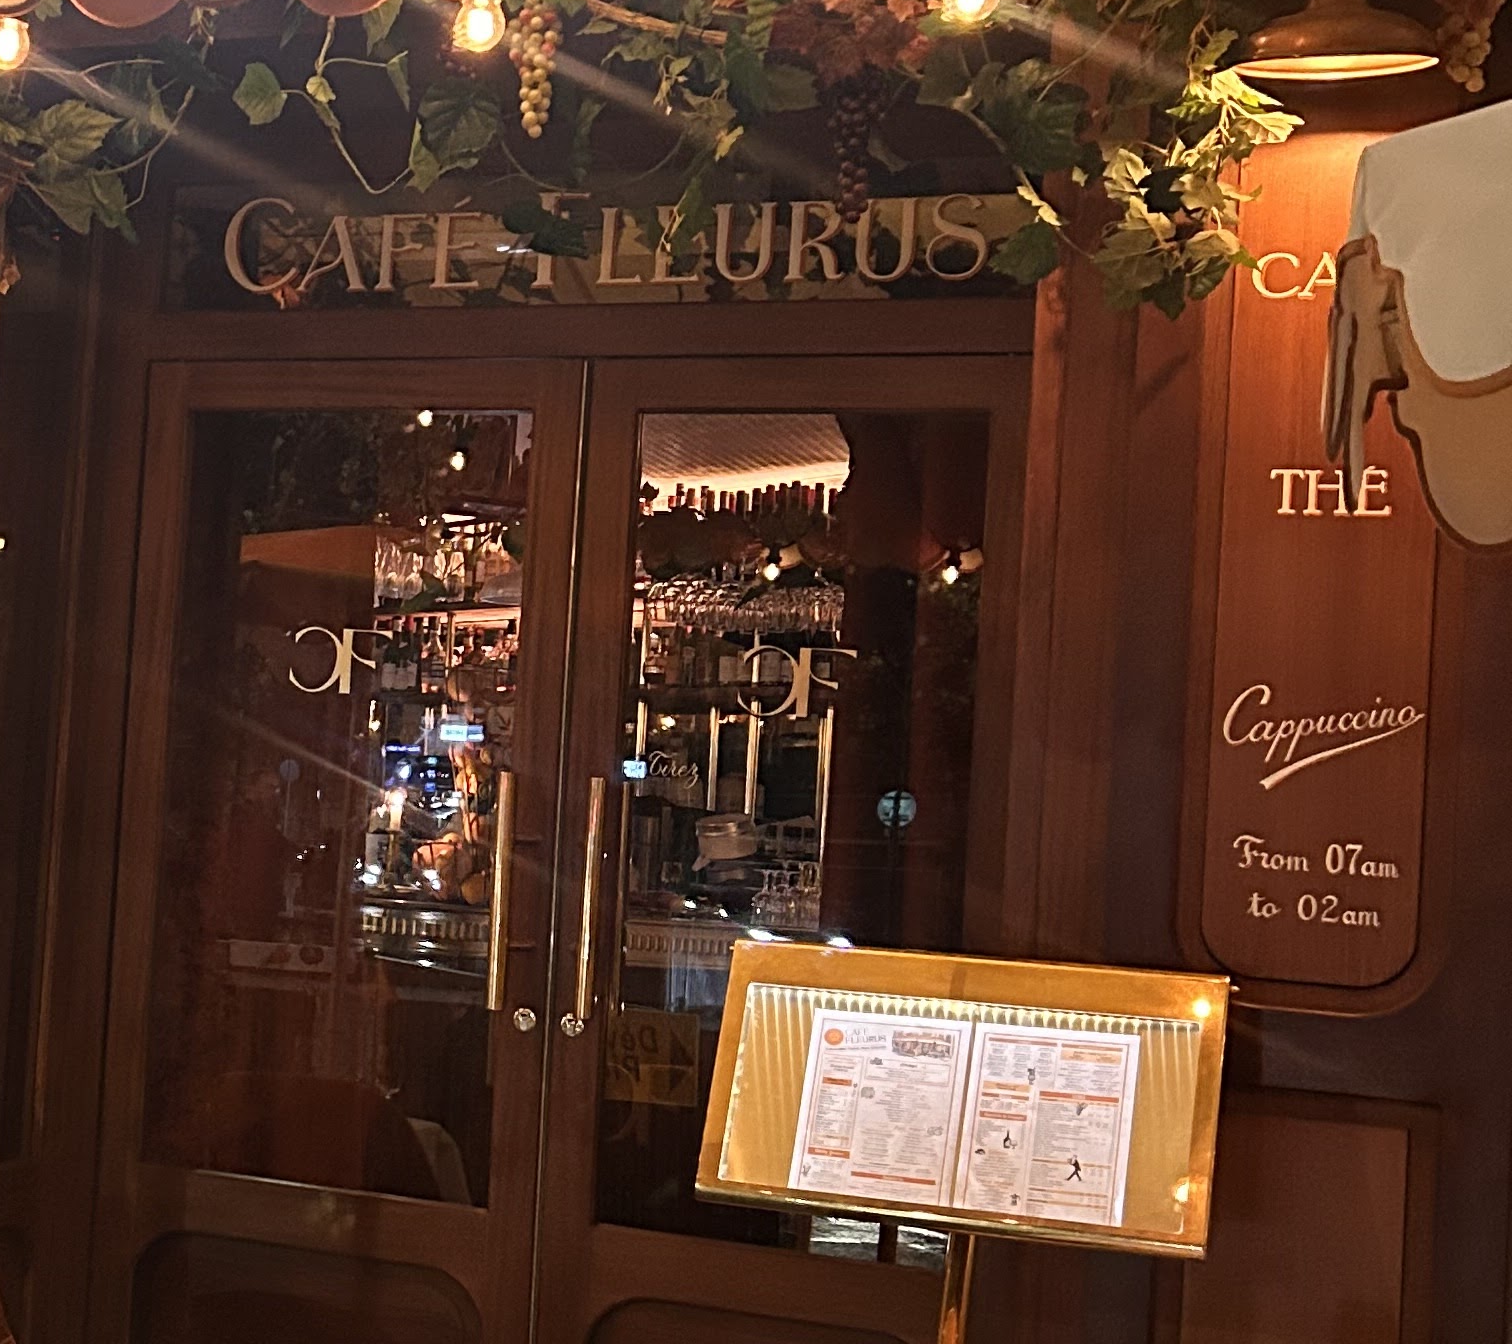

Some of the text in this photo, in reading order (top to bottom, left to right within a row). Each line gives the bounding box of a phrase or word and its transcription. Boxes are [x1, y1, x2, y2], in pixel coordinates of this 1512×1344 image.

[224, 194, 481, 295] CAFÉ
[1270, 465, 1392, 517] THÉ
[1223, 684, 1425, 763] Cappuccino
[649, 750, 699, 790] Tirez
[1233, 834, 1399, 878] From 07am
[1247, 892, 1381, 928] to 02am
